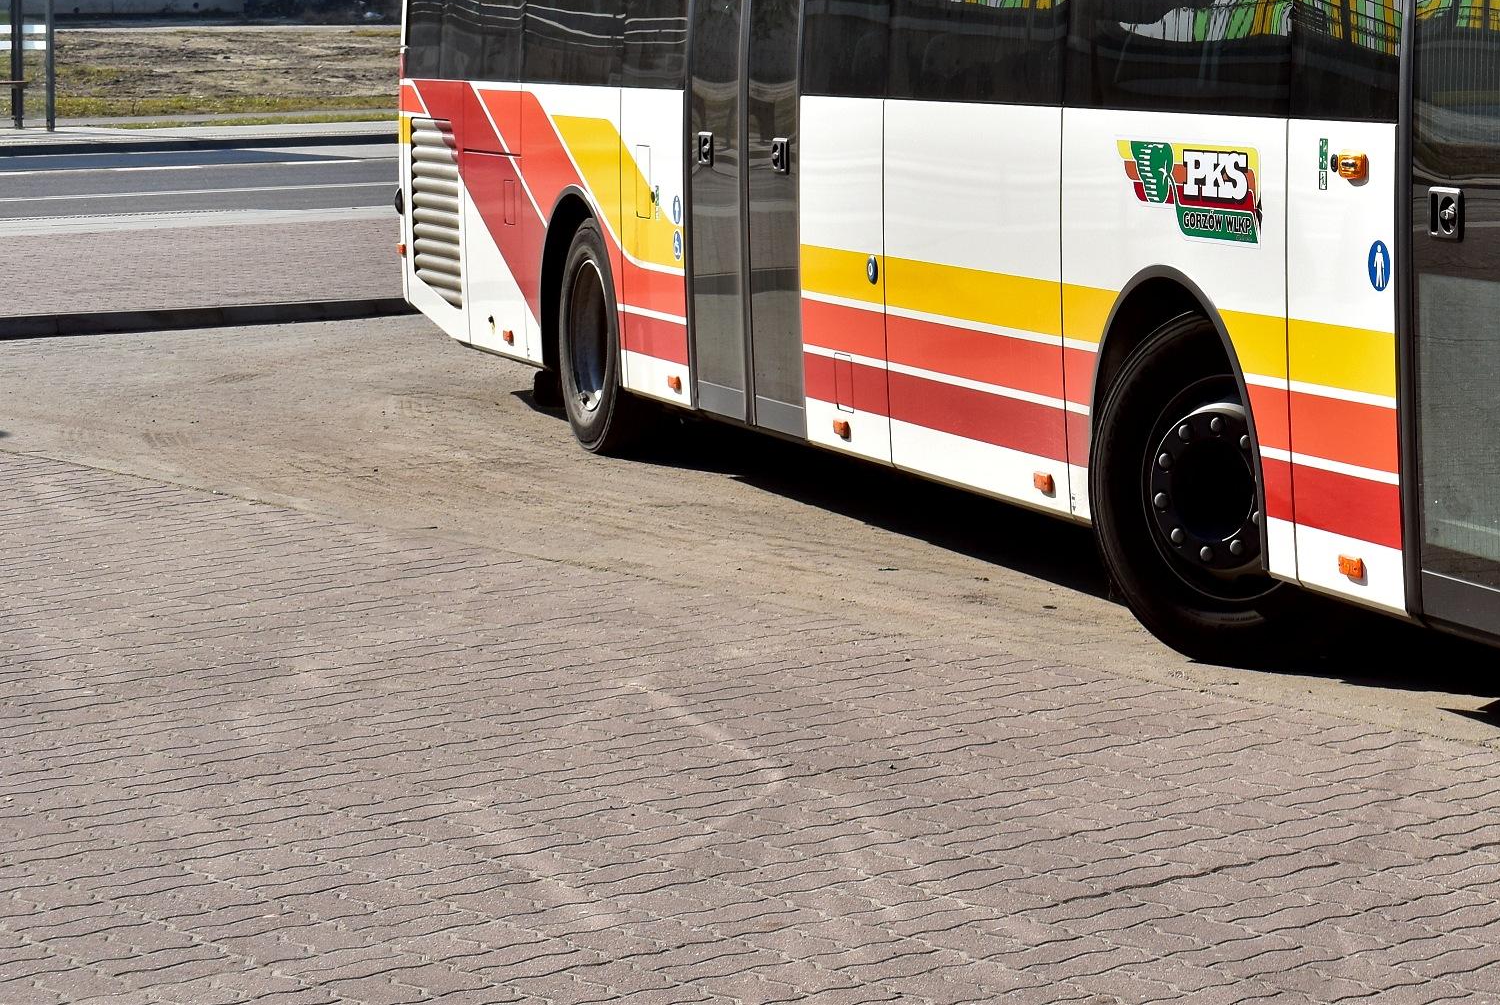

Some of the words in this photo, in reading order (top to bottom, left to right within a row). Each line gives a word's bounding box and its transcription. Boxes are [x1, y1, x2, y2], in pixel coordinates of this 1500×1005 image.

[1183, 149, 1248, 202] PKS
[1183, 209, 1224, 232] GORZÓW
[1225, 214, 1253, 236] WLKP.
